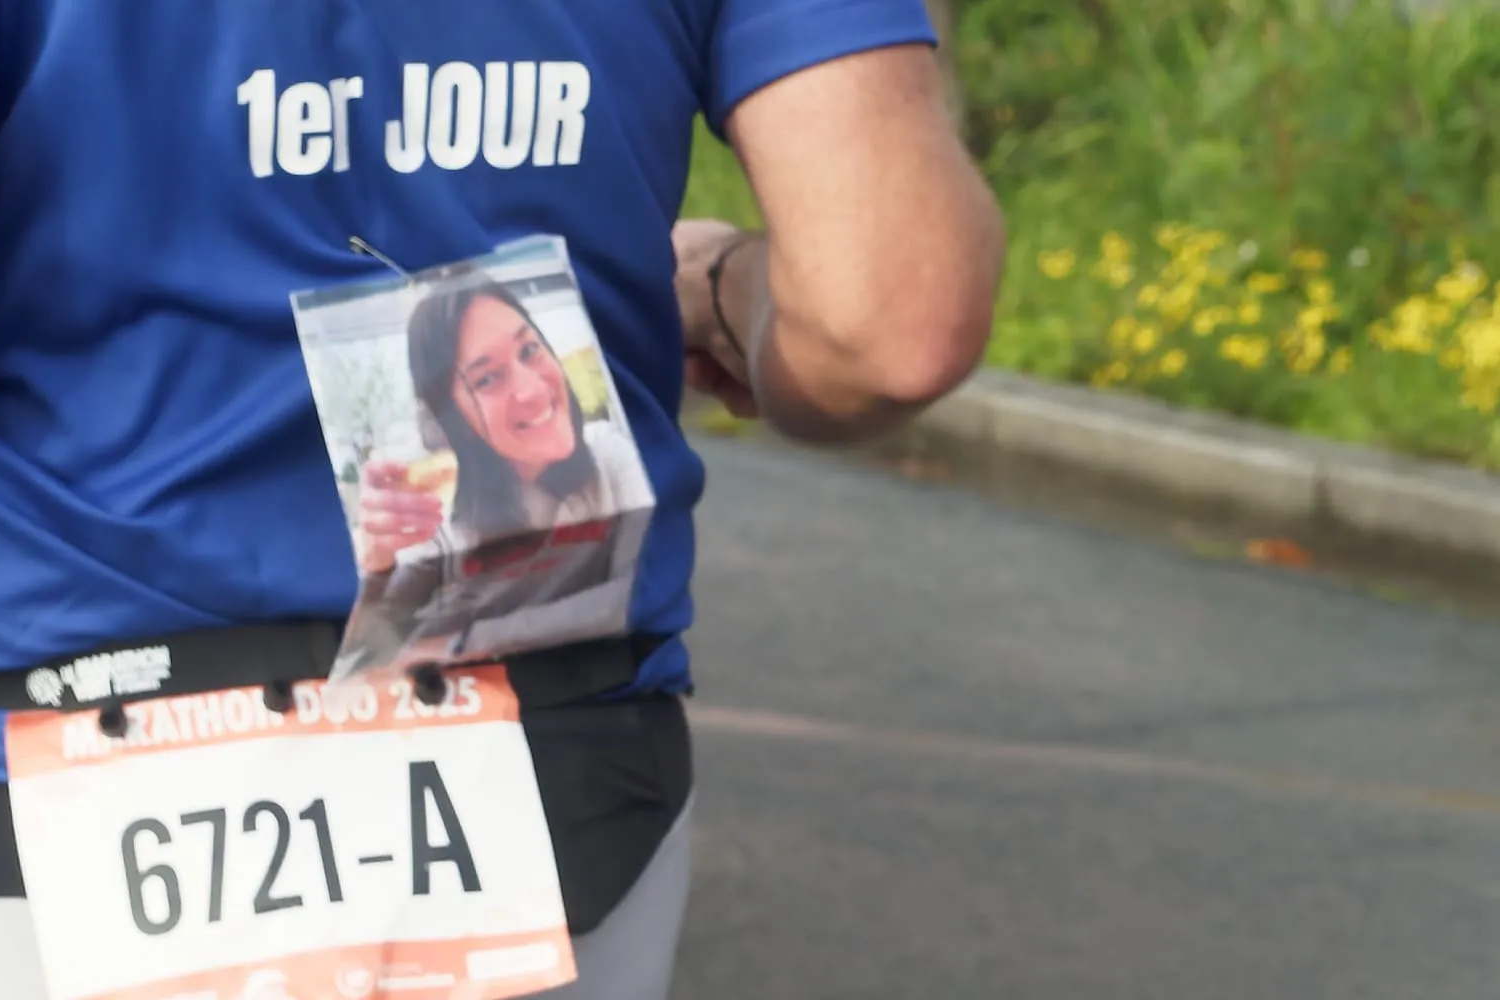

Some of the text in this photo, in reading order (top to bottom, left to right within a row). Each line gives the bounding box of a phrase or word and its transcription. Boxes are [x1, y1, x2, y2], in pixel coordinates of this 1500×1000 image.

[237, 60, 591, 177] 1er JOUR
[293, 681, 378, 725] DUO
[120, 760, 482, 936] 6721-A
